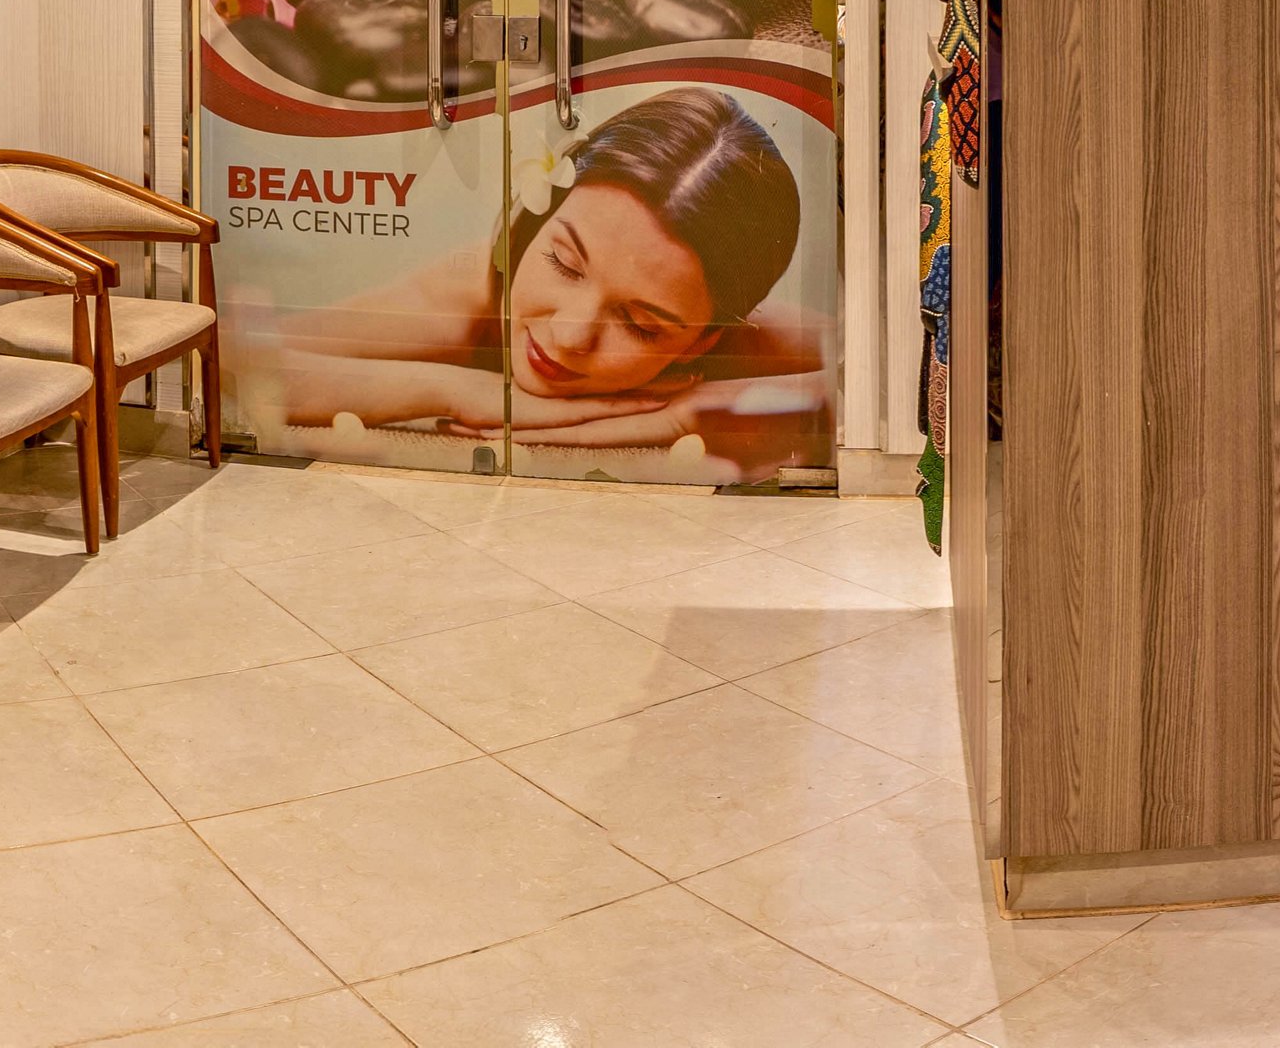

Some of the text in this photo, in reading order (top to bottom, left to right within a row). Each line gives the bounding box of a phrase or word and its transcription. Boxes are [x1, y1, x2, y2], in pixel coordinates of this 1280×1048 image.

[228, 165, 418, 206] BEAUTY
[228, 206, 410, 238] SPA CENTER
